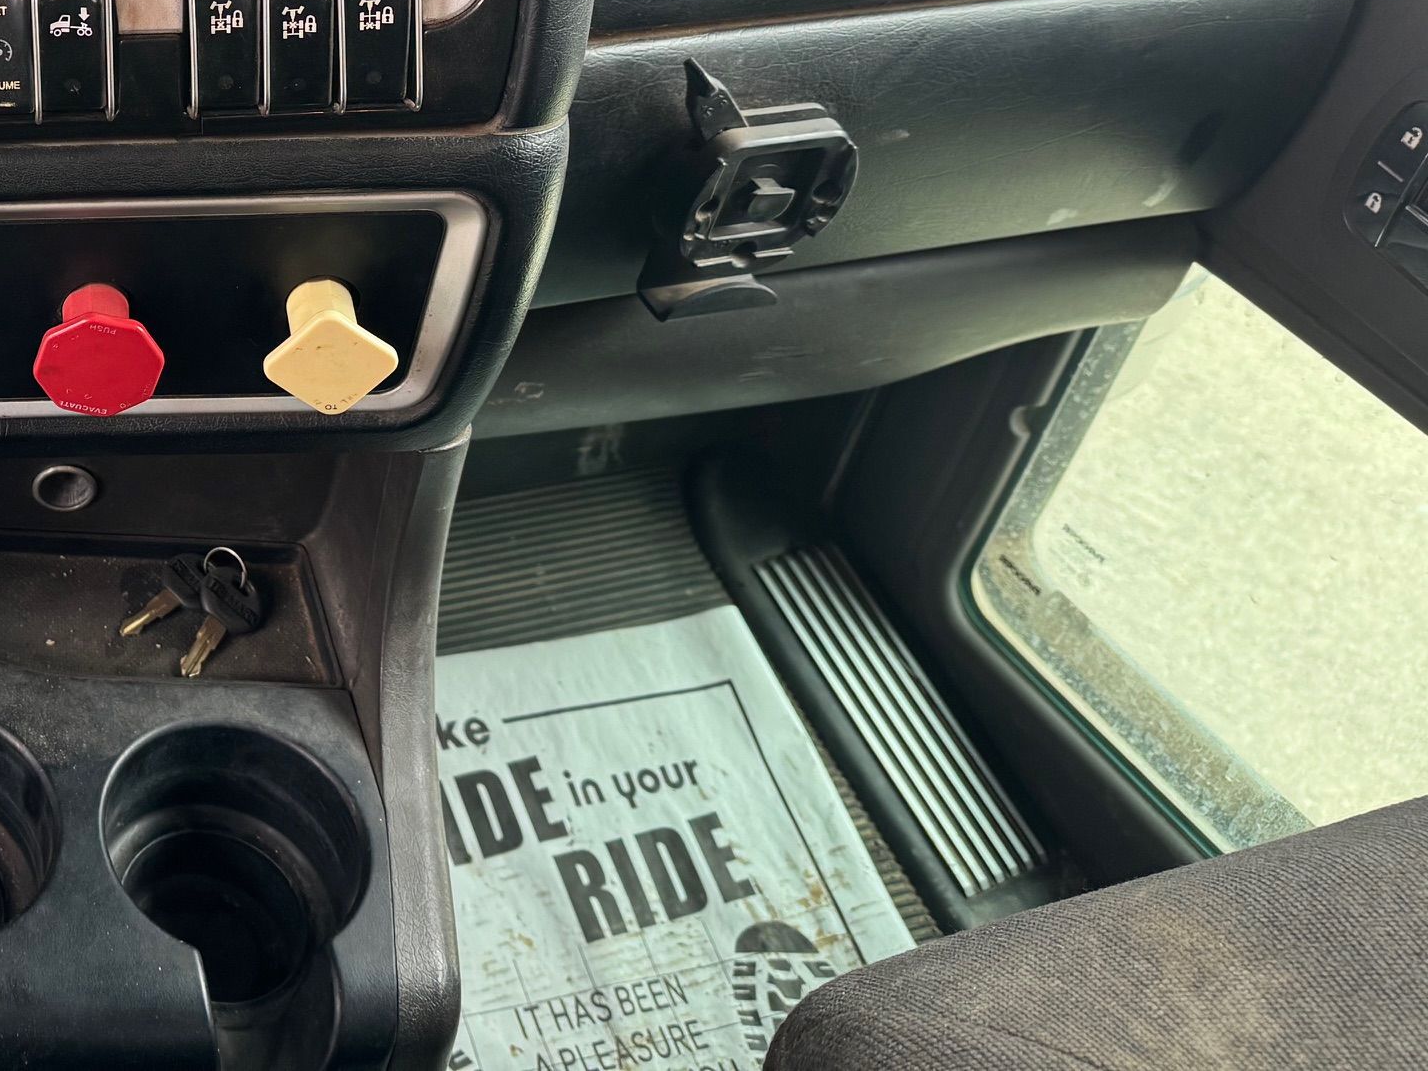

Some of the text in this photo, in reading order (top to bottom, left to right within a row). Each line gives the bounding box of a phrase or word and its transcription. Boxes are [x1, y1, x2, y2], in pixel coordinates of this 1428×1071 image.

[89, 324, 117, 335] PUSH
[562, 770, 606, 807] in
[611, 758, 699, 809] your
[553, 811, 756, 944] RIDE
[514, 974, 690, 1039] IT HAS BEEN
[558, 1019, 710, 1071] PLEASURE
